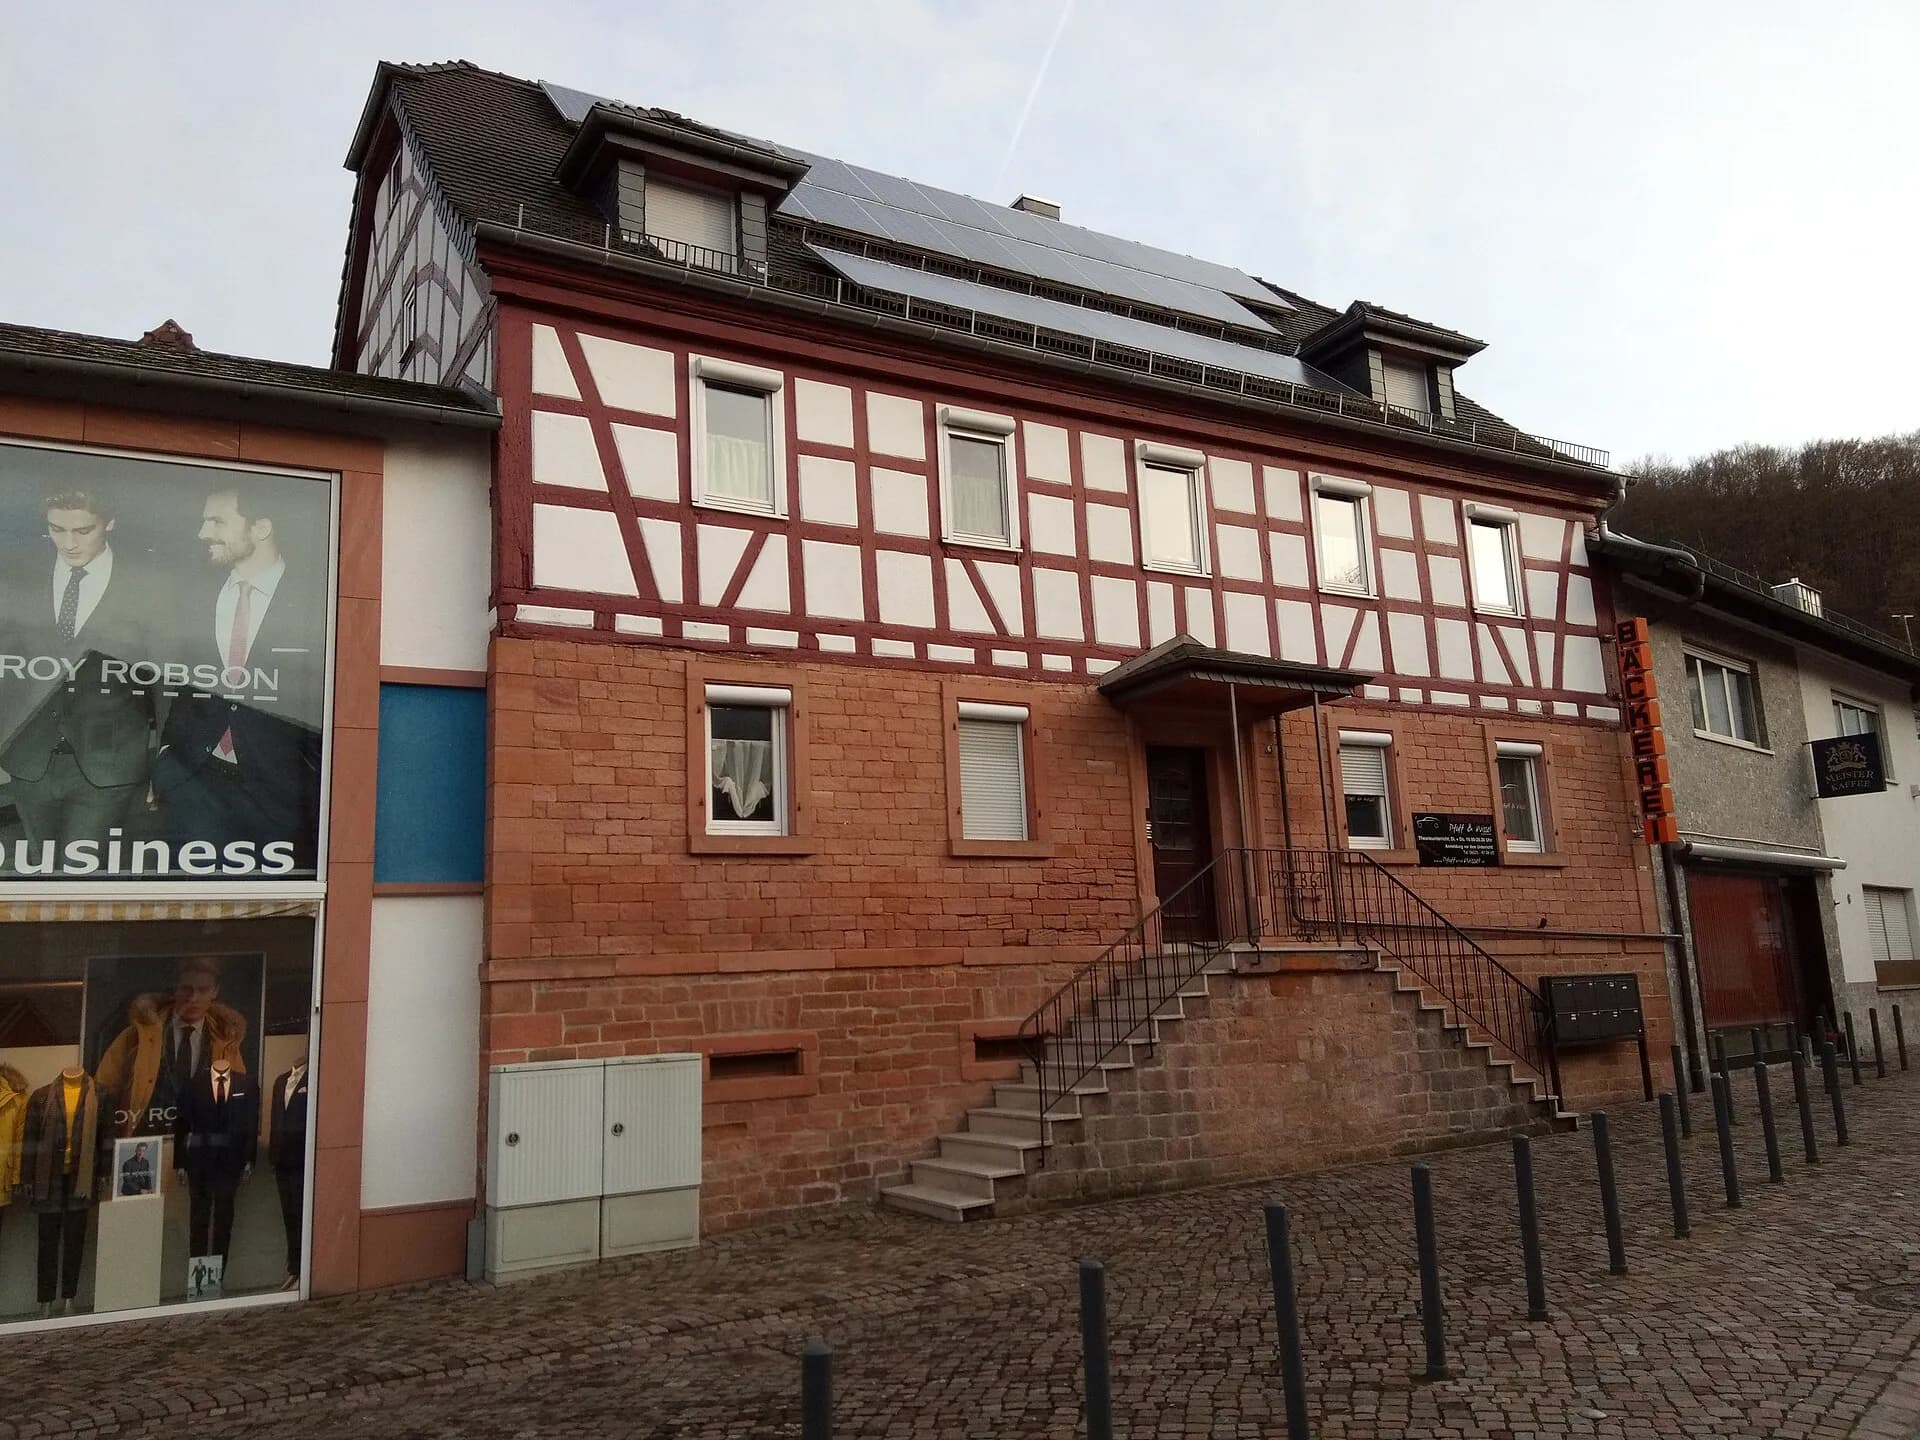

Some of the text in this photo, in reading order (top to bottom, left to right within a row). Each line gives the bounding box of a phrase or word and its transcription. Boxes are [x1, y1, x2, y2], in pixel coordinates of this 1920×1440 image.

[0, 654, 279, 690] ROY ROBSON
[1824, 770, 1874, 784] MEISTER
[1467, 823, 1473, 832] &
[0, 828, 295, 875] usiness
